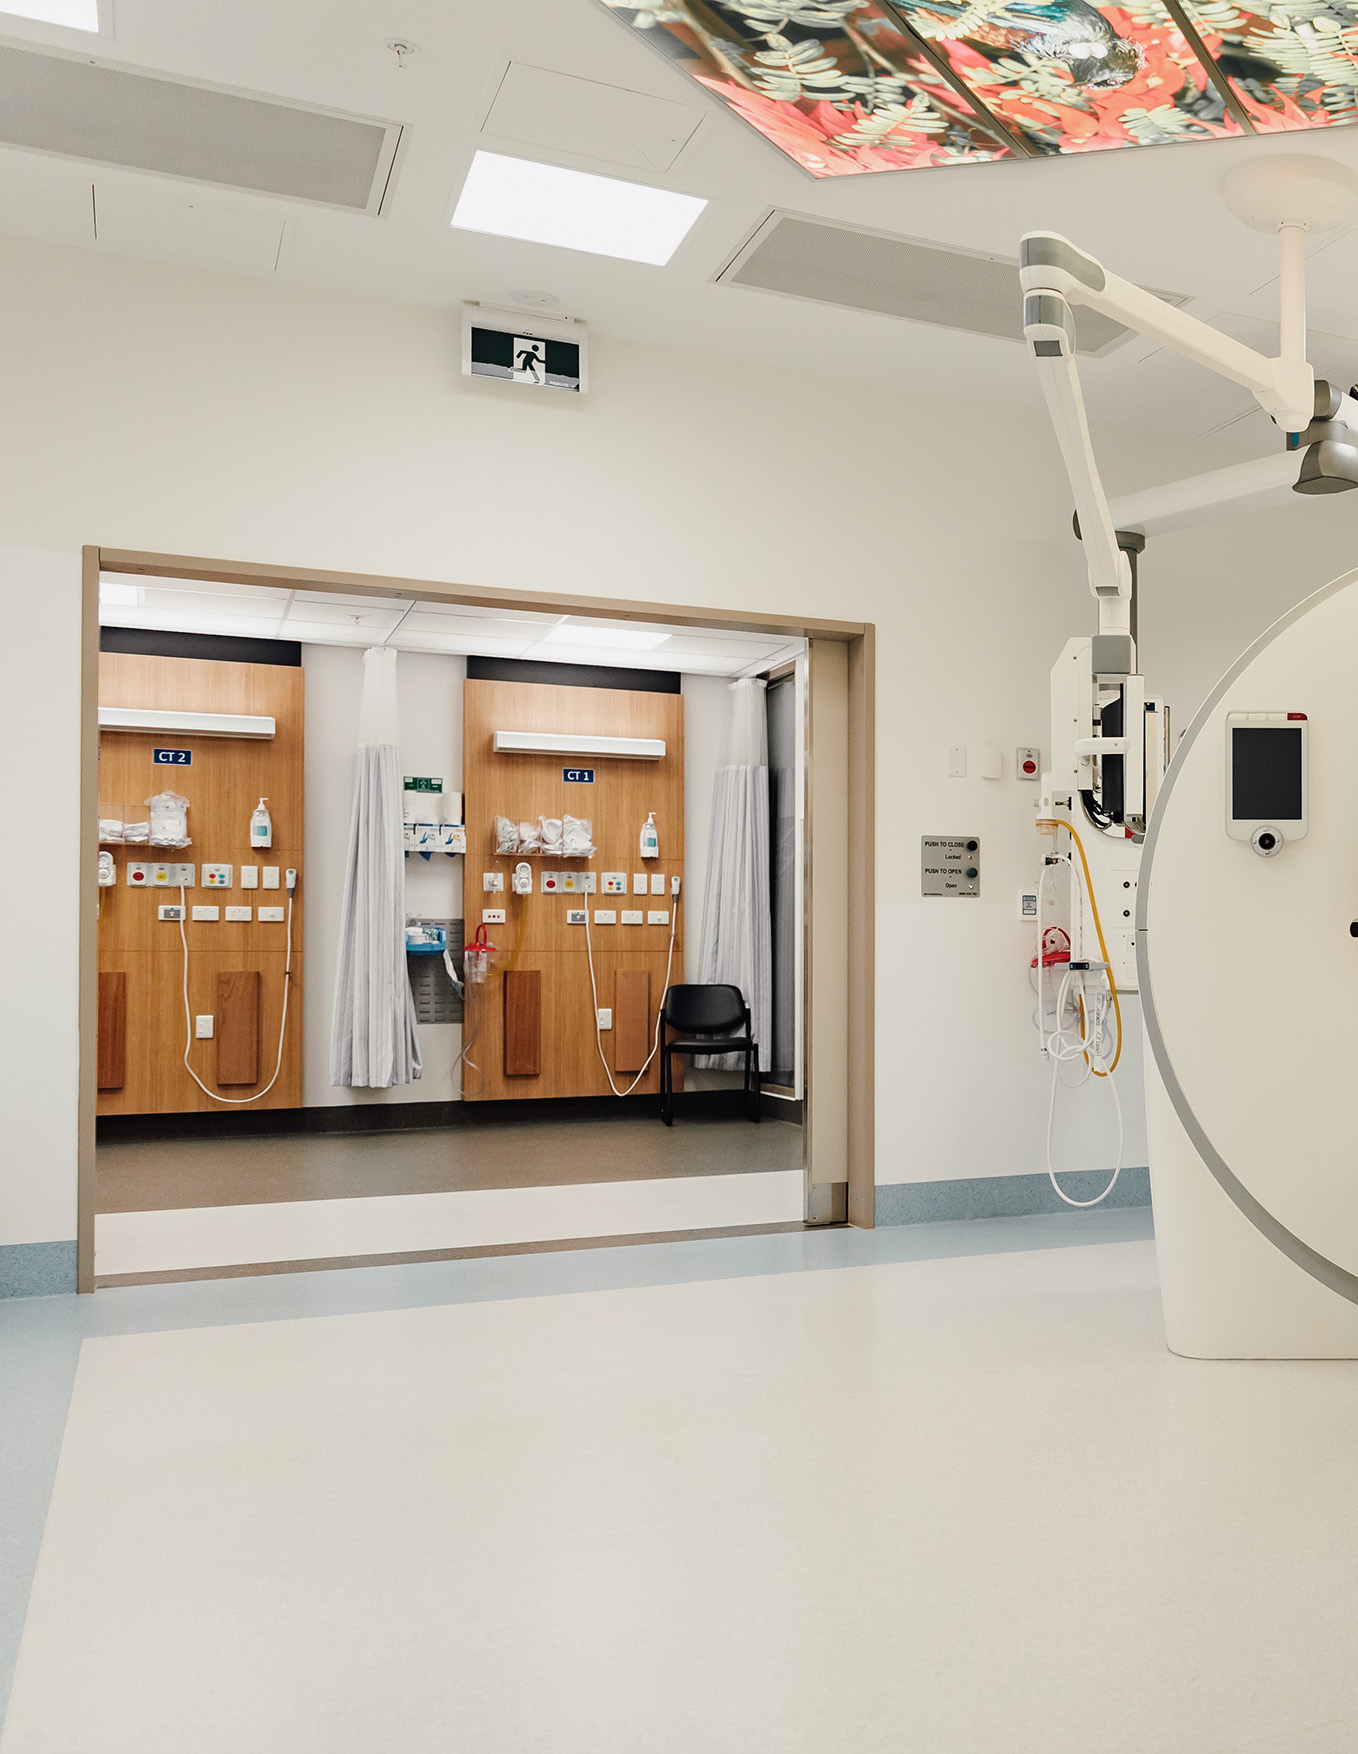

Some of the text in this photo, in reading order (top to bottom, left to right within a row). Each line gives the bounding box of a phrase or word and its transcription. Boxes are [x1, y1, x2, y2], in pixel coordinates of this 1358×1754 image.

[158, 751, 186, 763] CT 2
[567, 770, 590, 781] CT 1
